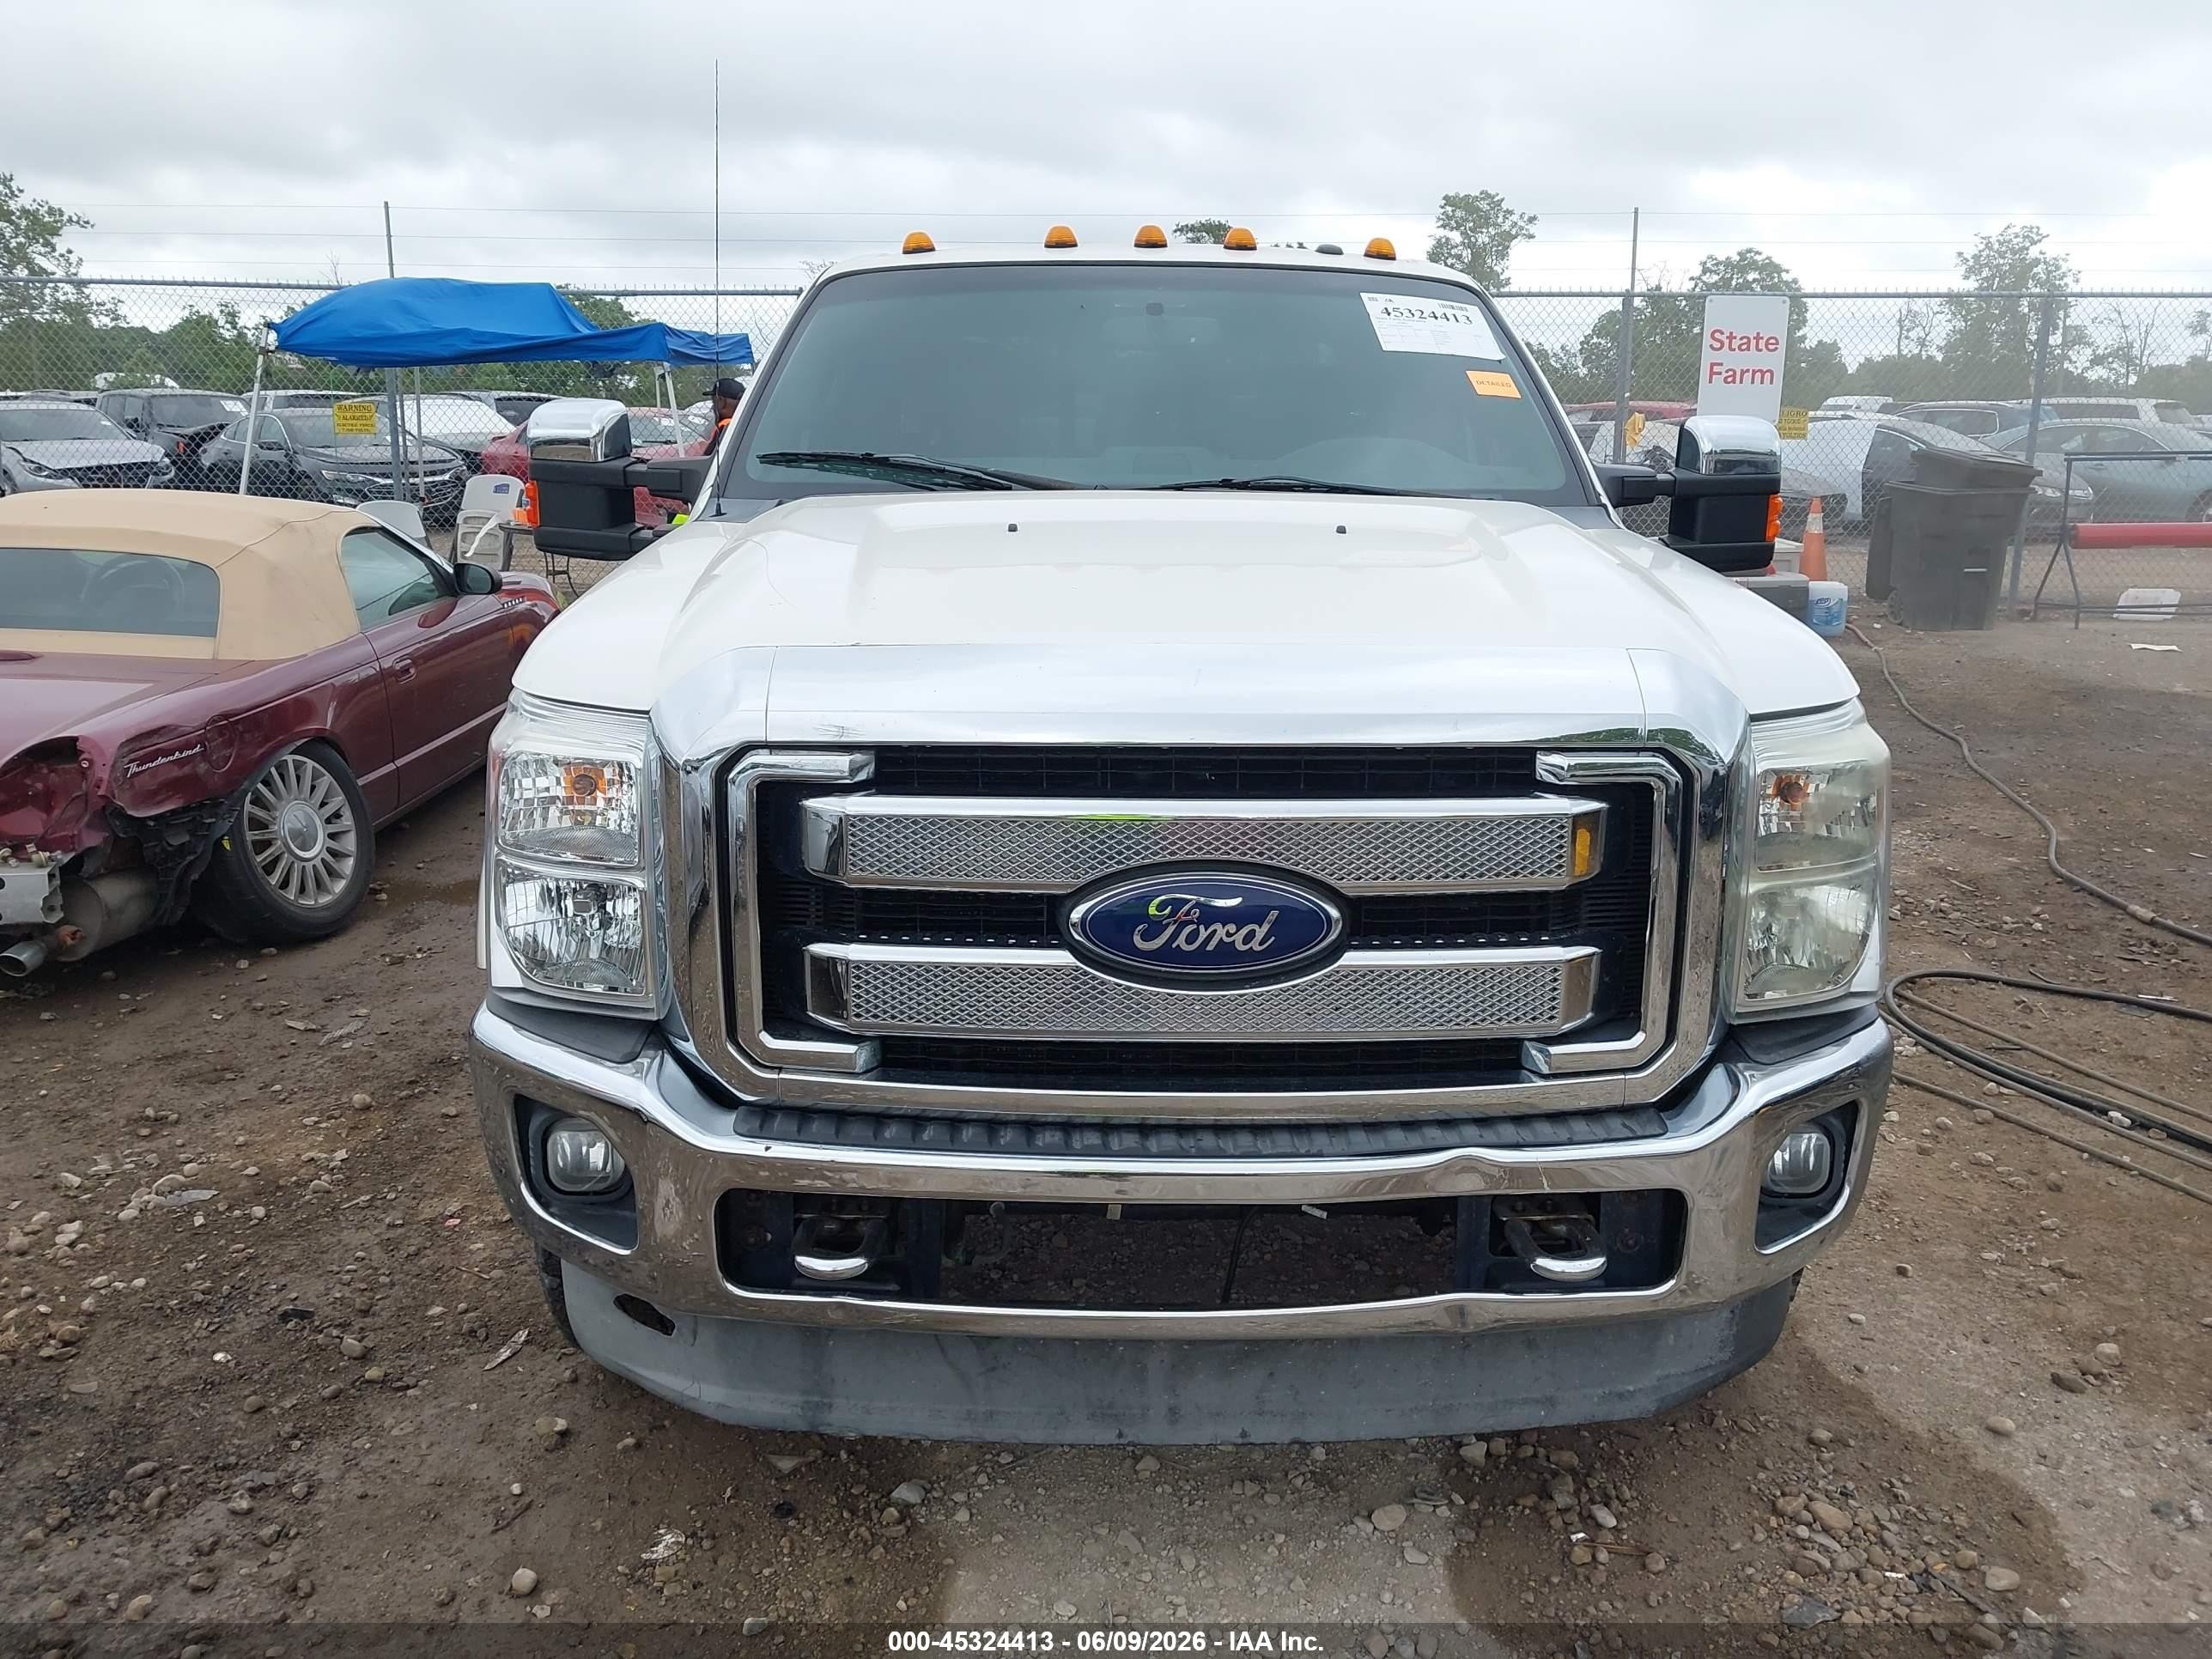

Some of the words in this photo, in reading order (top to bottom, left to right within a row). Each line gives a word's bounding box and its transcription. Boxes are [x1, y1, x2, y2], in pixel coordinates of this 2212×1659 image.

[1380, 307, 1473, 325] 45324413
[1709, 329, 1780, 353] State
[1708, 362, 1775, 386] Farm
[123, 744, 205, 778] Thunderbird
[1133, 893, 1279, 951] Ford
